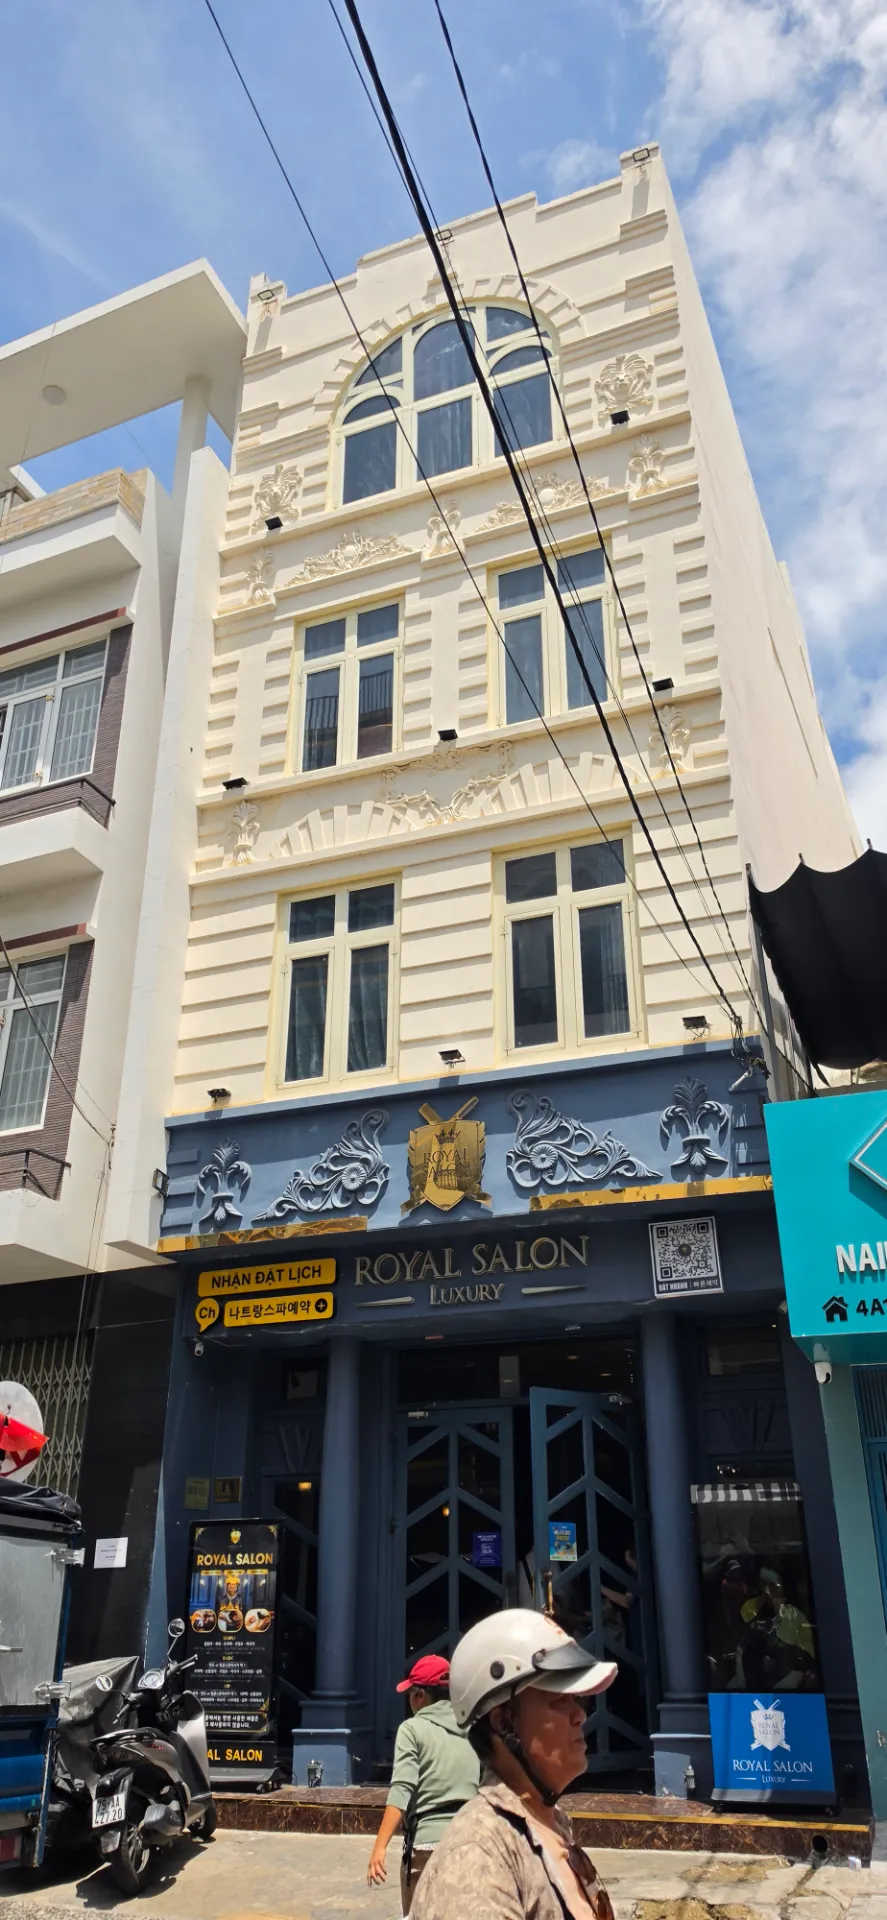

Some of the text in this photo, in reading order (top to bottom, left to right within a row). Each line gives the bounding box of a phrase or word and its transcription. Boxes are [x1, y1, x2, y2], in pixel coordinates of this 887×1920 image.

[424, 1147, 471, 1165] ROYAL
[354, 1235, 590, 1286] ROYAL SALON
[211, 1264, 322, 1290] NHẬN ĐẶT LỊCH
[429, 1283, 505, 1306] LUXURY
[199, 1306, 216, 1320] Ch
[229, 1300, 311, 1320] 나트랑스파예약
[196, 1552, 274, 1566] ROYAL SALON
[225, 1748, 263, 1761] SALON
[732, 1759, 813, 1773] ROYAL SALON
[761, 1775, 787, 1784] LUXURY
